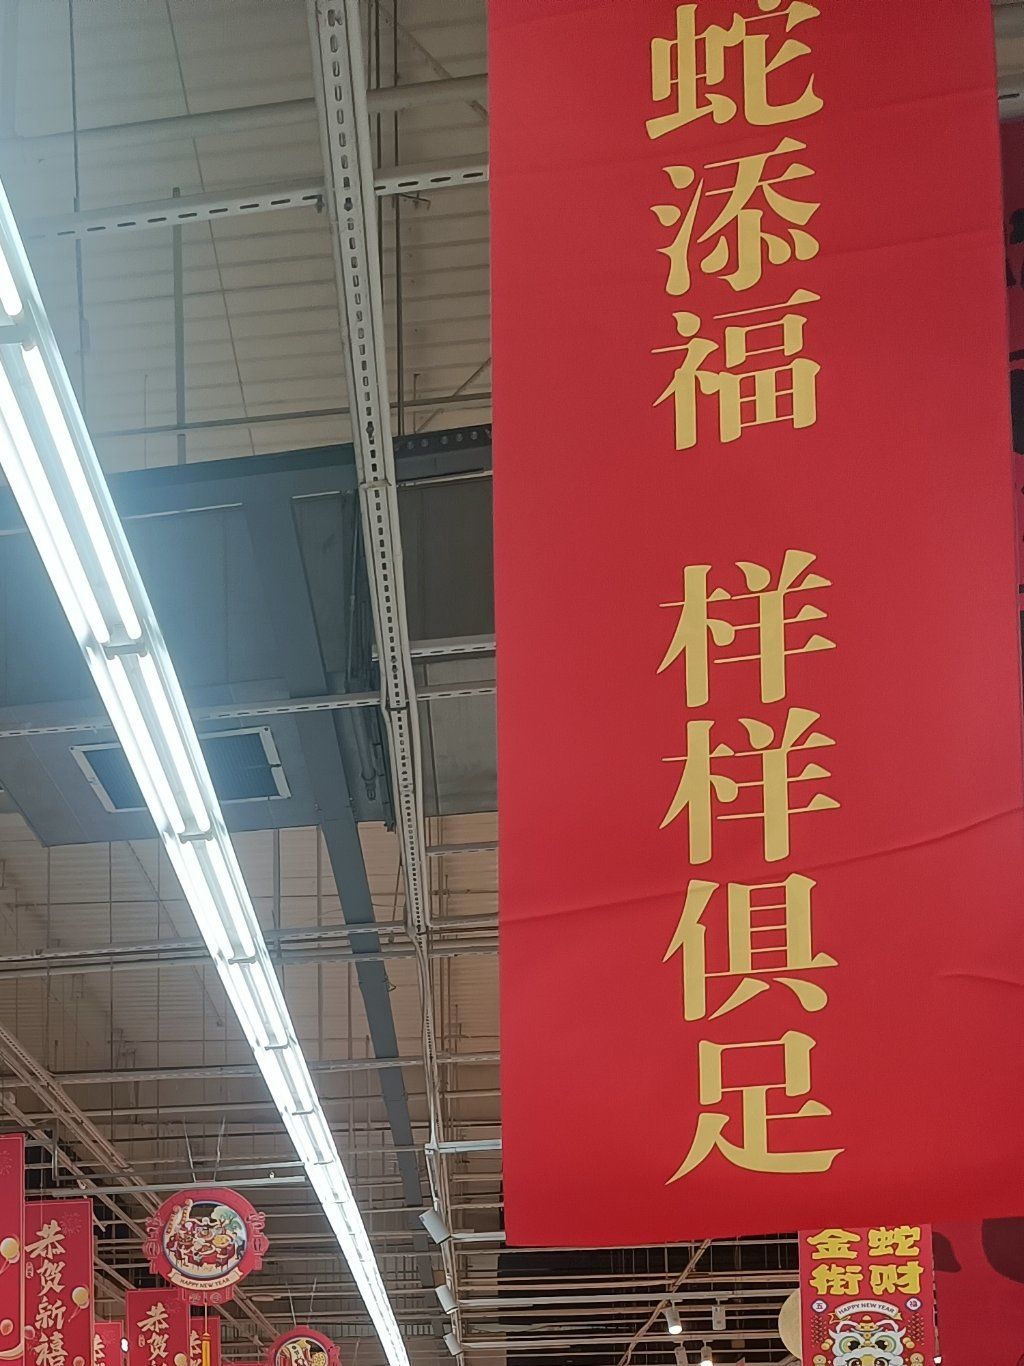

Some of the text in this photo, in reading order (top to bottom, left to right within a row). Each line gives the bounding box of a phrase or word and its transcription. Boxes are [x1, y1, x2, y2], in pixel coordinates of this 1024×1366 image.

[656, 548, 845, 1188] 样样俱足
[807, 1226, 922, 1260] 金蛇
[838, 1303, 860, 1314] HAPPY
[878, 1304, 895, 1314] YEAR
